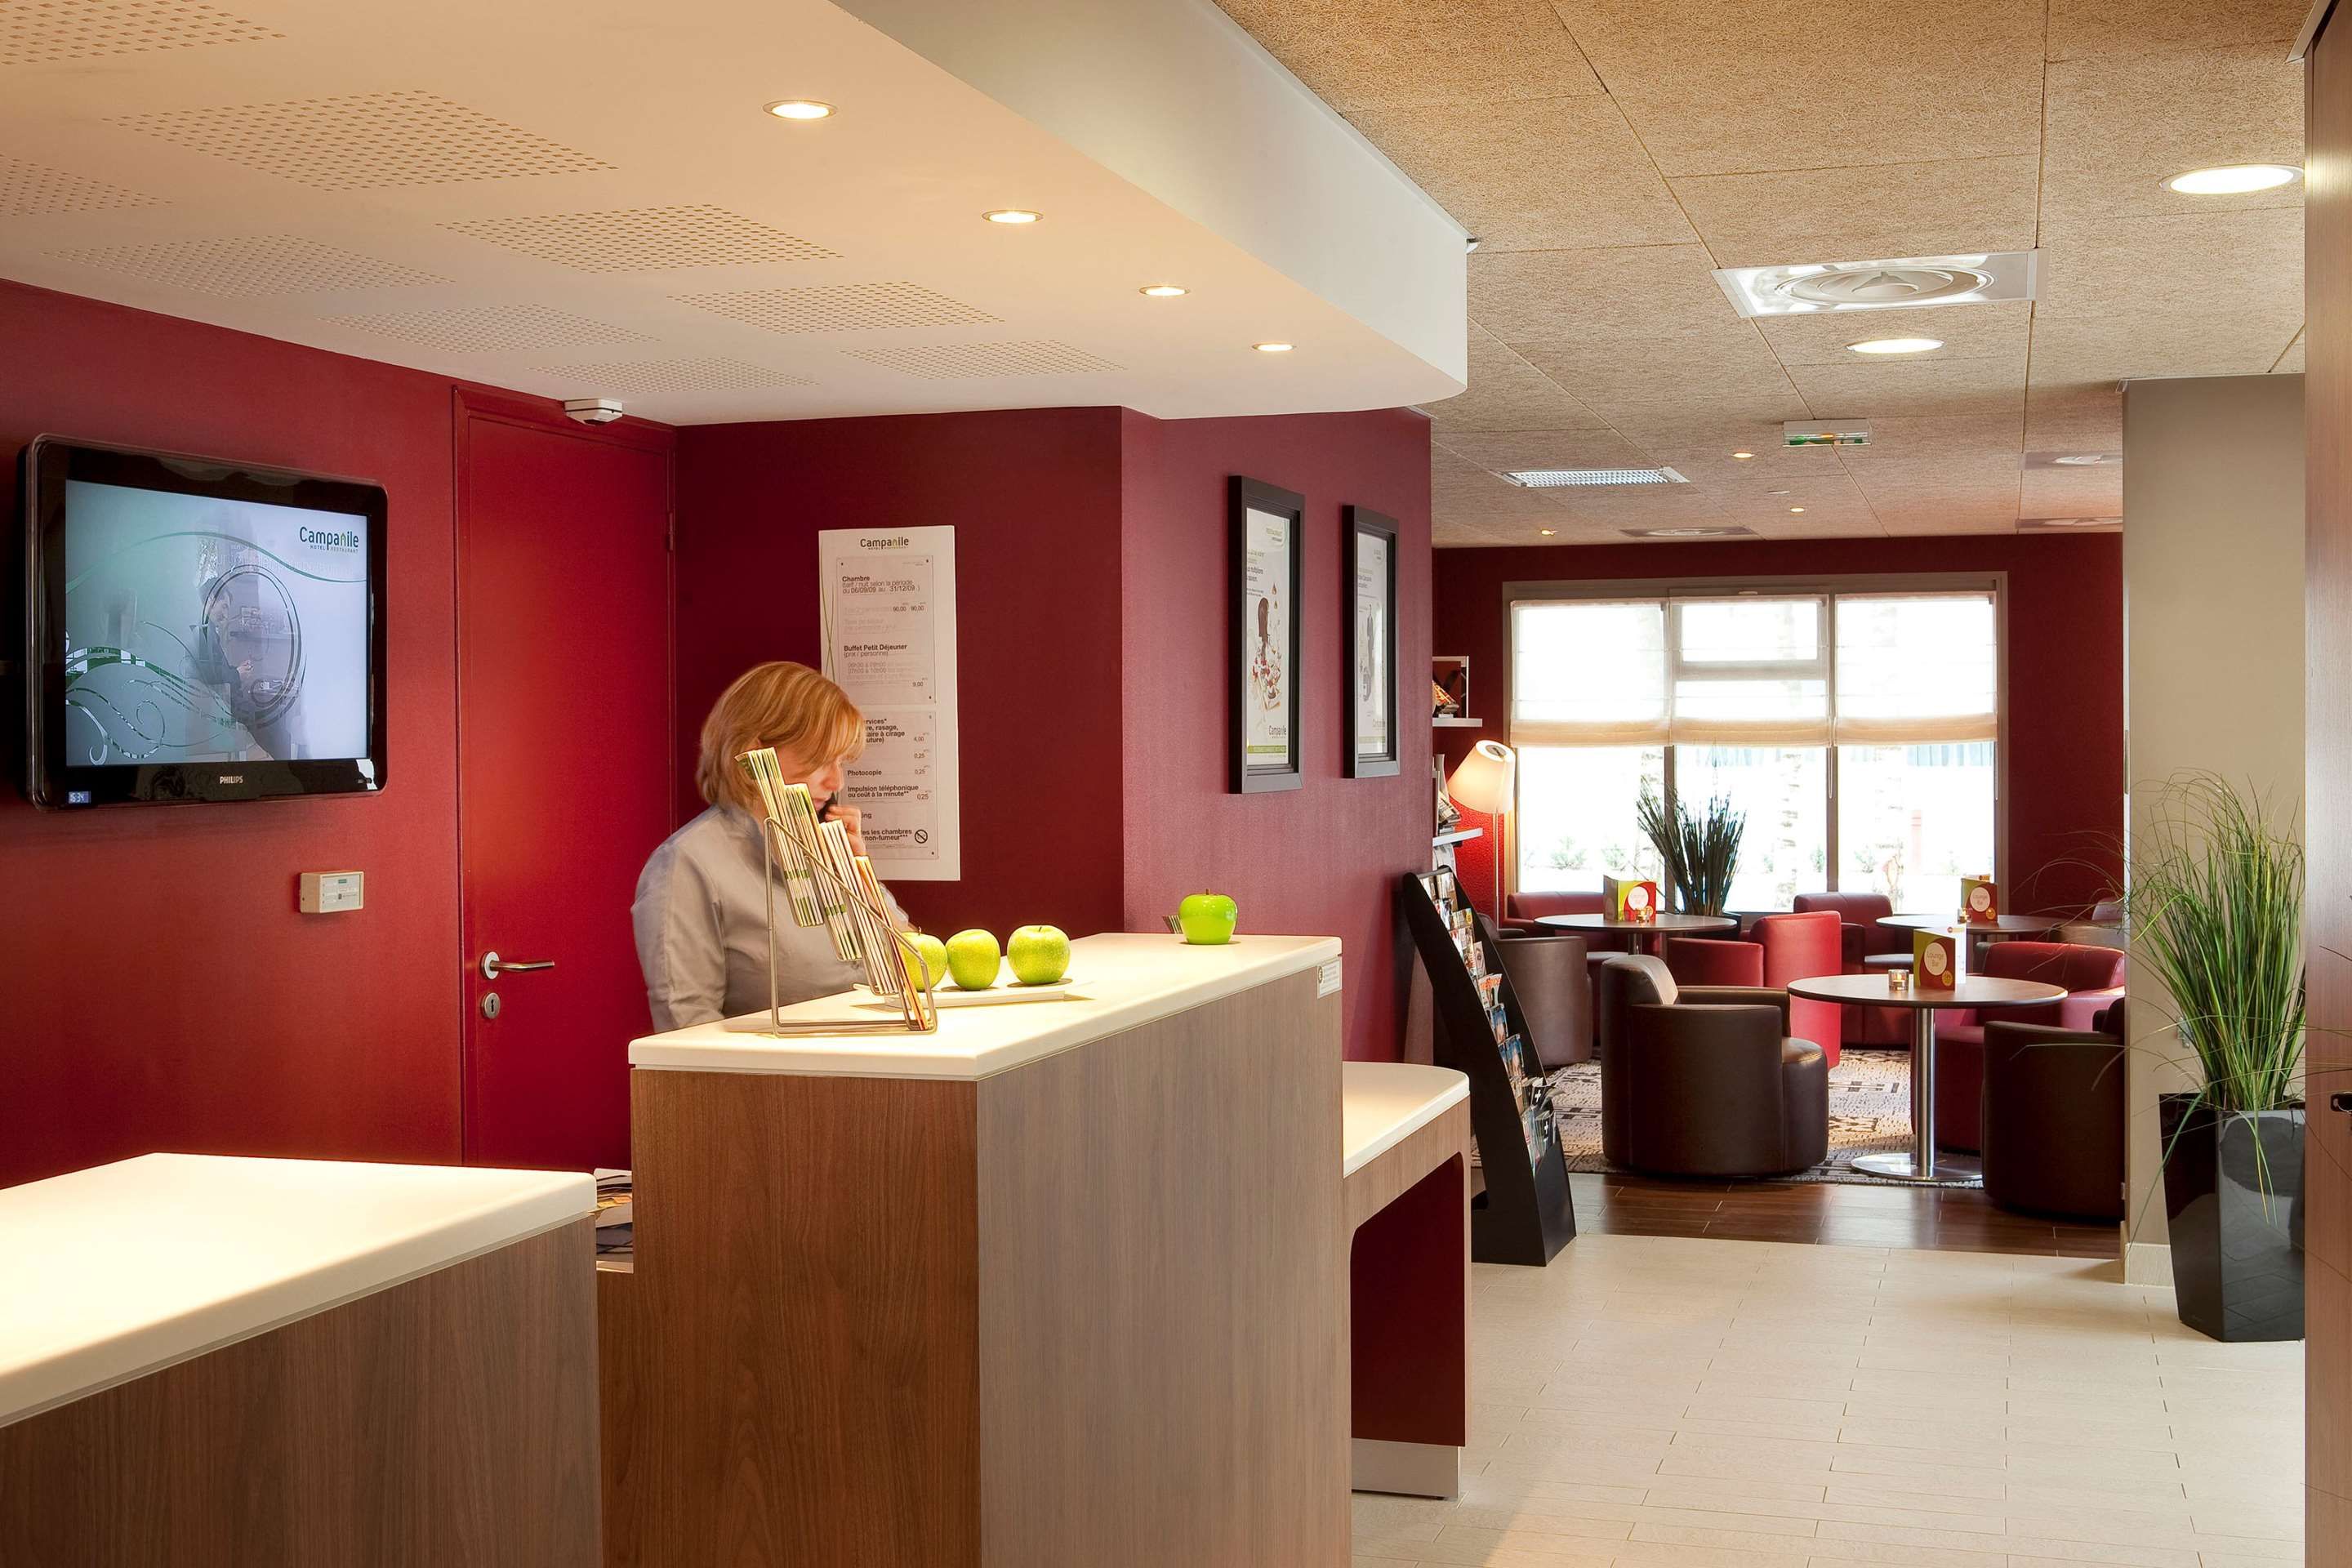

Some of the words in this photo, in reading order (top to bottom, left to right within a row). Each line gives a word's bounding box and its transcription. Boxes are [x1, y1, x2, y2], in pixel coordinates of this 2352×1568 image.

[300, 527, 359, 550] Campanile
[860, 537, 909, 550] Campanile
[220, 776, 243, 784] PHILIPS
